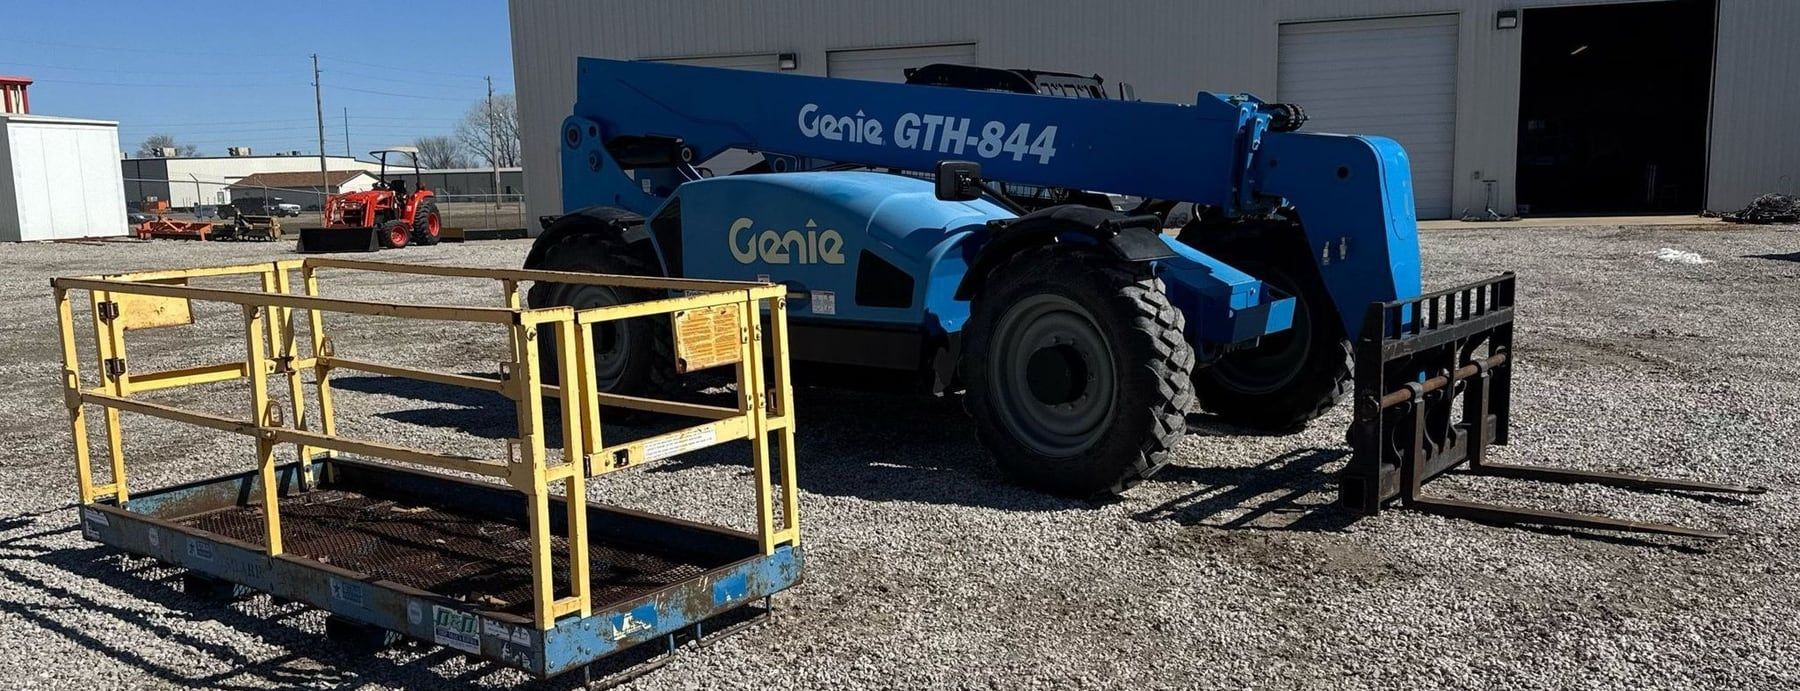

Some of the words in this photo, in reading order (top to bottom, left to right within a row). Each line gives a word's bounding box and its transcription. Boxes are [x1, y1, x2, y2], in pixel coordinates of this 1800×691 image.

[799, 103, 884, 146] Genie
[894, 112, 1058, 165] GTH-844
[728, 217, 845, 264] Genie
